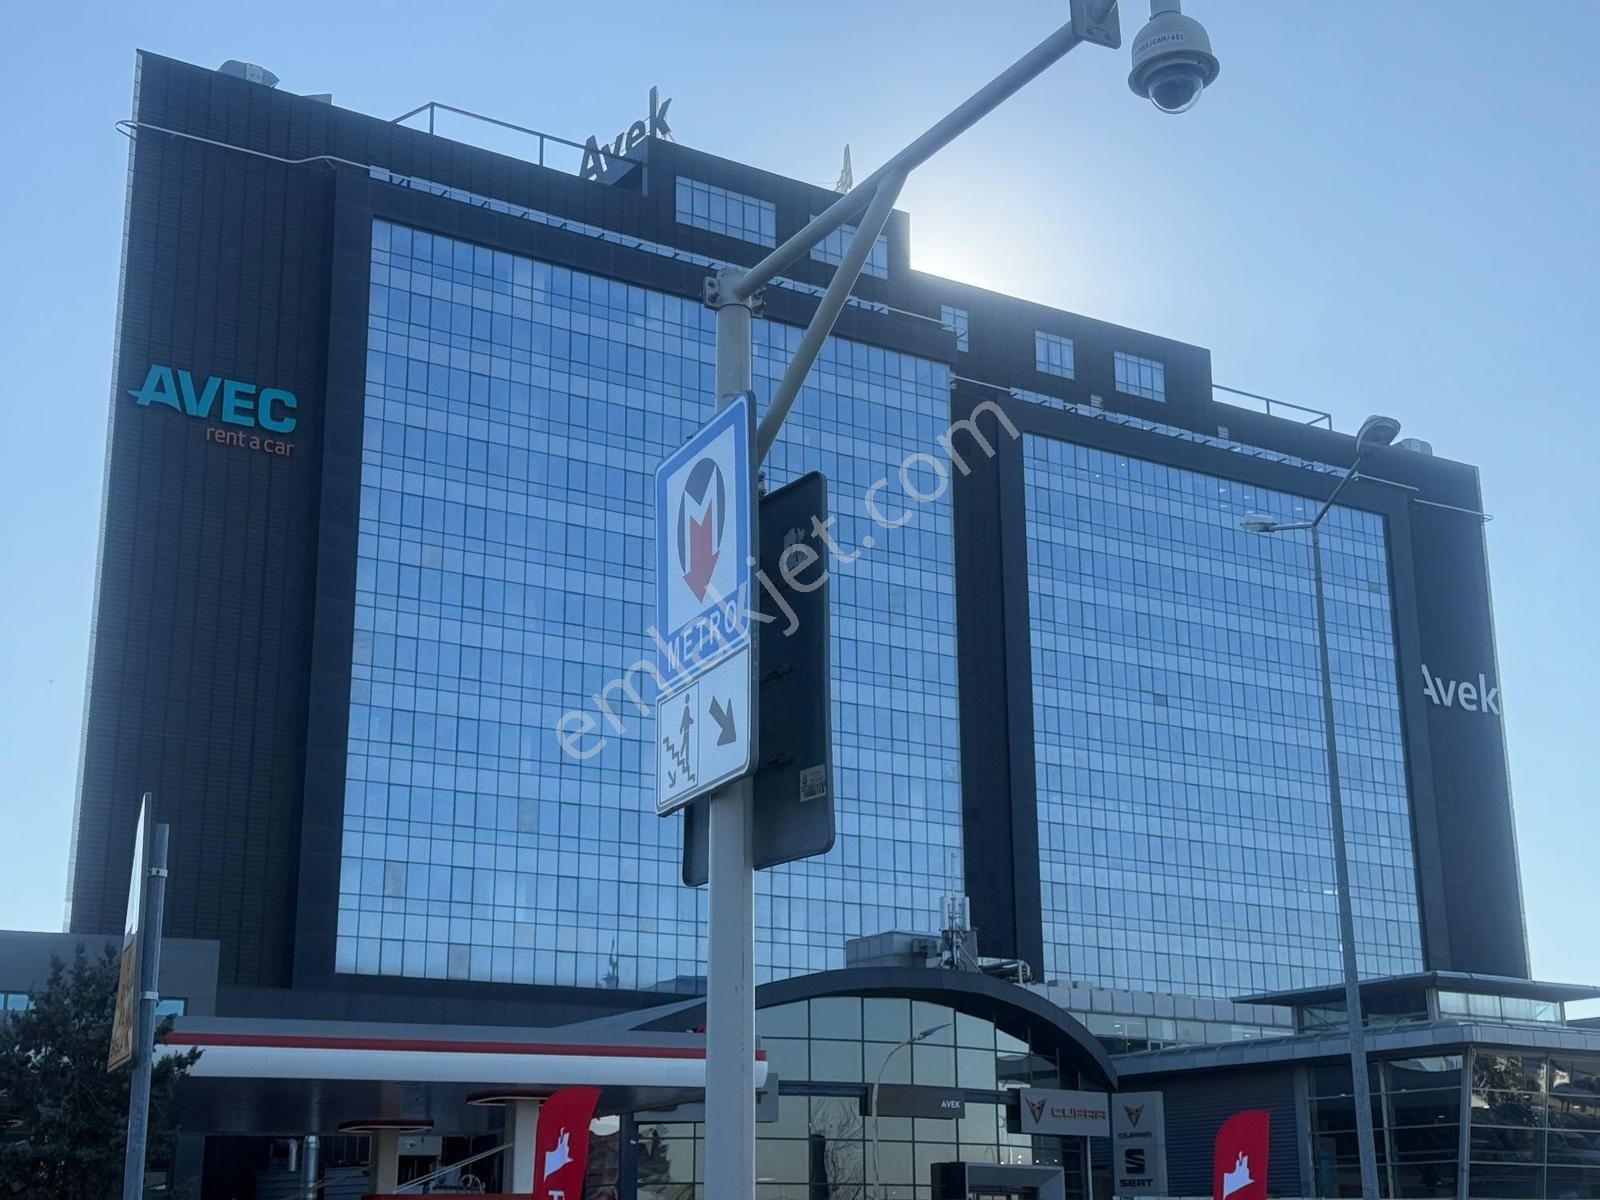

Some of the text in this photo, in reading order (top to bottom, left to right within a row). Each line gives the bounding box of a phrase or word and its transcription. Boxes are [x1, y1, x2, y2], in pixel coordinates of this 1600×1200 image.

[580, 85, 673, 182] Avek
[127, 363, 298, 434] AVEC
[206, 426, 295, 457] rent a car
[667, 599, 737, 672] METRO
[1421, 663, 1501, 716] Avek
[1119, 1178, 1154, 1188] SEAT
